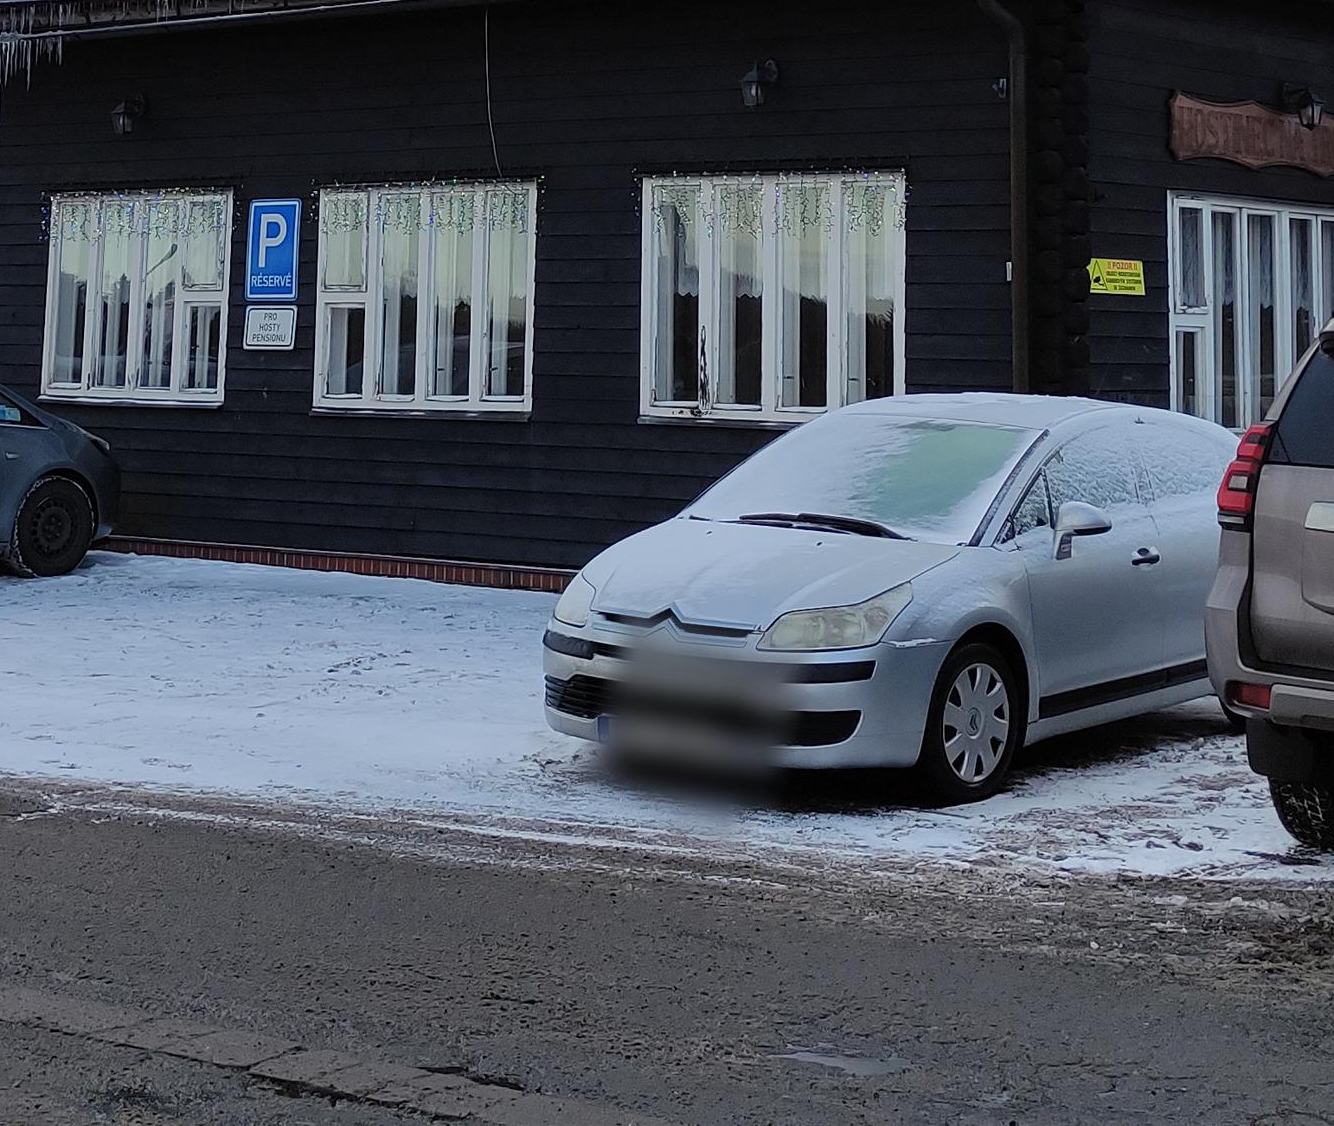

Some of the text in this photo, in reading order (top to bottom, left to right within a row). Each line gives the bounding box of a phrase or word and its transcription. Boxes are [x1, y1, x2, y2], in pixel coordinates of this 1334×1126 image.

[258, 213, 287, 268] P
[1112, 261, 1132, 270] POZOR
[251, 272, 292, 288] RÉSERVÉ
[263, 312, 278, 321] PRO
[259, 322, 281, 332] HOSTY
[251, 333, 286, 342] PENSIONU
